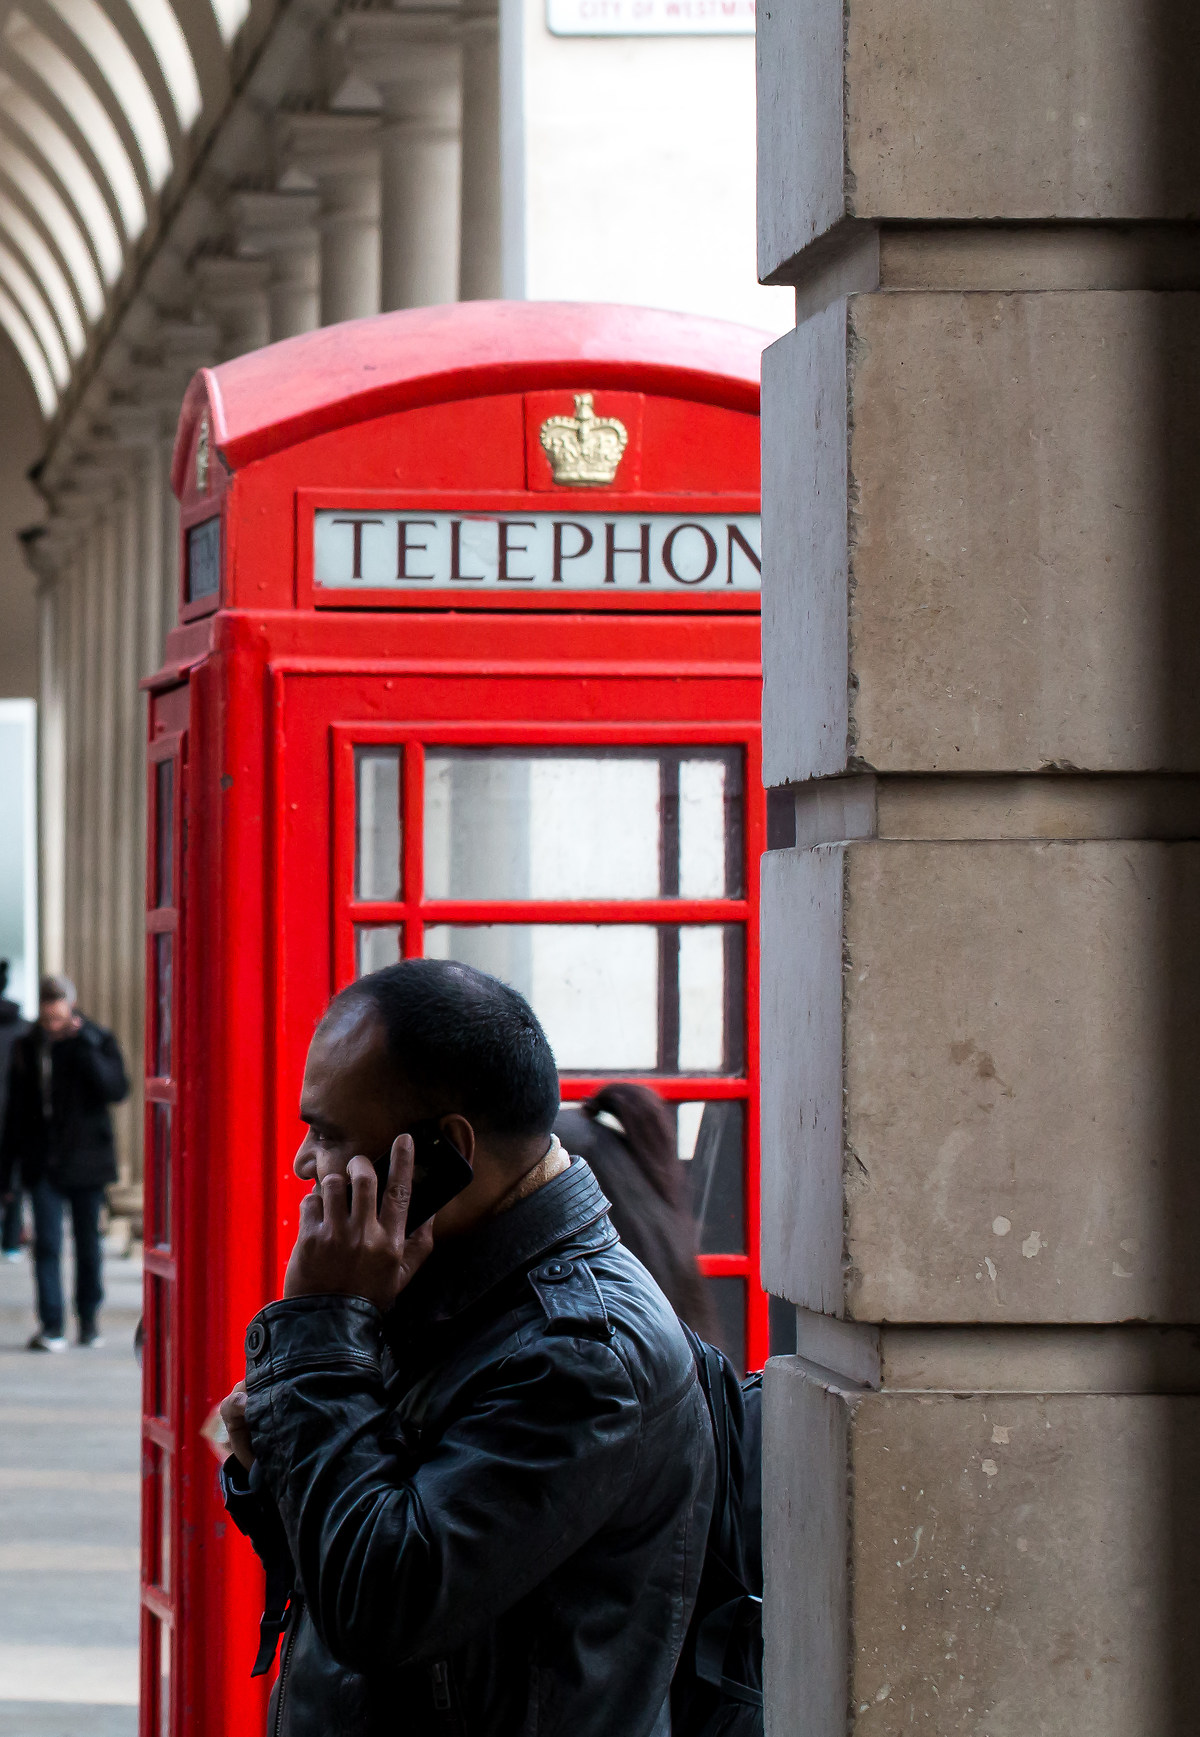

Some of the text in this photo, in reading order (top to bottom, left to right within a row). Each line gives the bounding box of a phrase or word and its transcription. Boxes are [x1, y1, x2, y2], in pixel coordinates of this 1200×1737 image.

[579, 0, 621, 19] CITY
[632, 0, 653, 19] OF
[332, 519, 762, 586] TELEPHON
